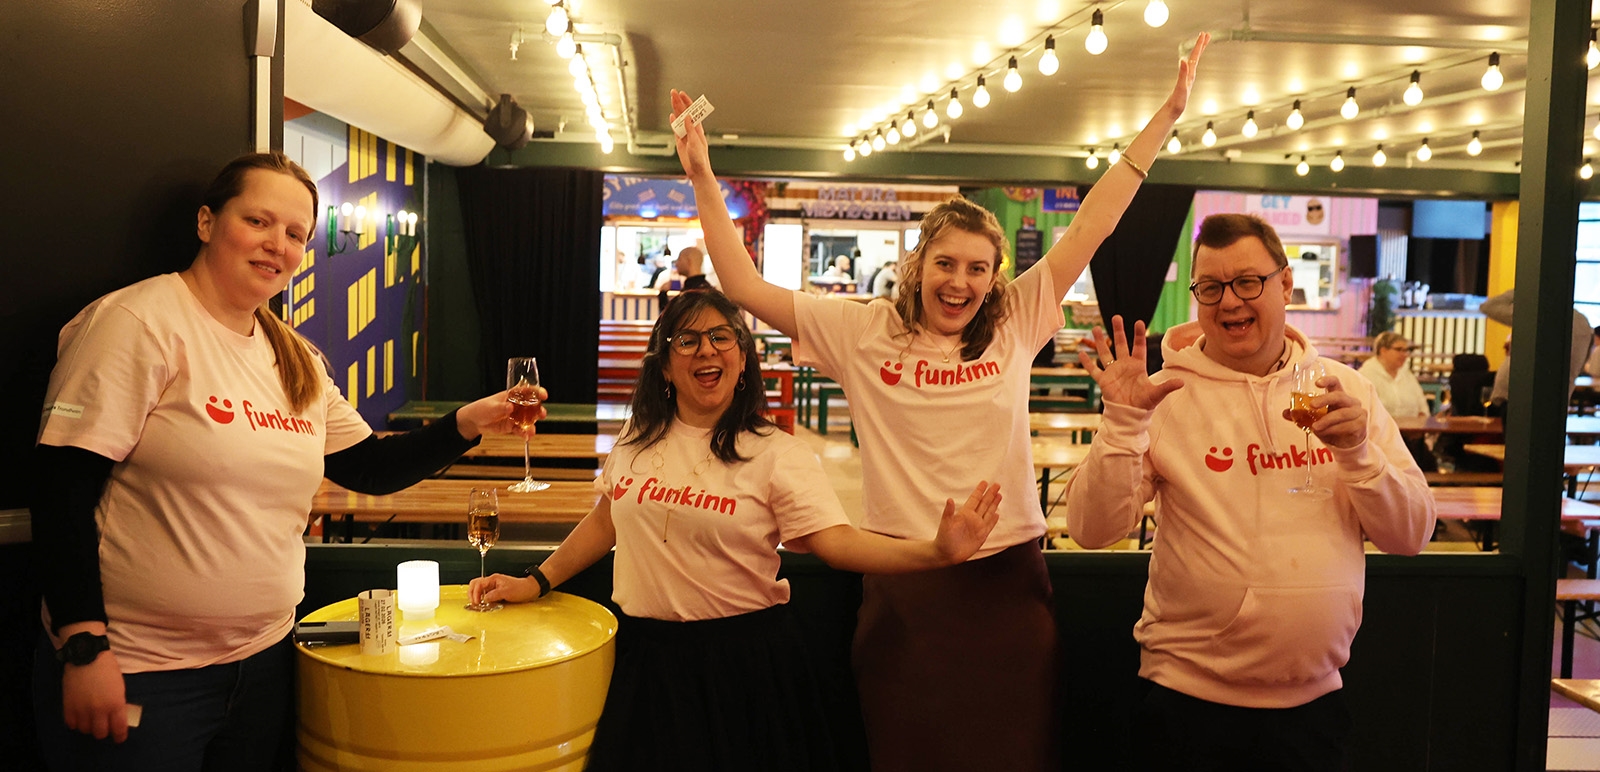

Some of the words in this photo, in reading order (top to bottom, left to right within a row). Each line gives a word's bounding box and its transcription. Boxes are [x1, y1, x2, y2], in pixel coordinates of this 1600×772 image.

[818, 186, 858, 202] MAT
[861, 187, 898, 202] FRA
[914, 360, 1001, 388] funkinn
[242, 399, 317, 437] funkinn
[1246, 443, 1333, 476] funkin
[637, 477, 736, 516] funkinn
